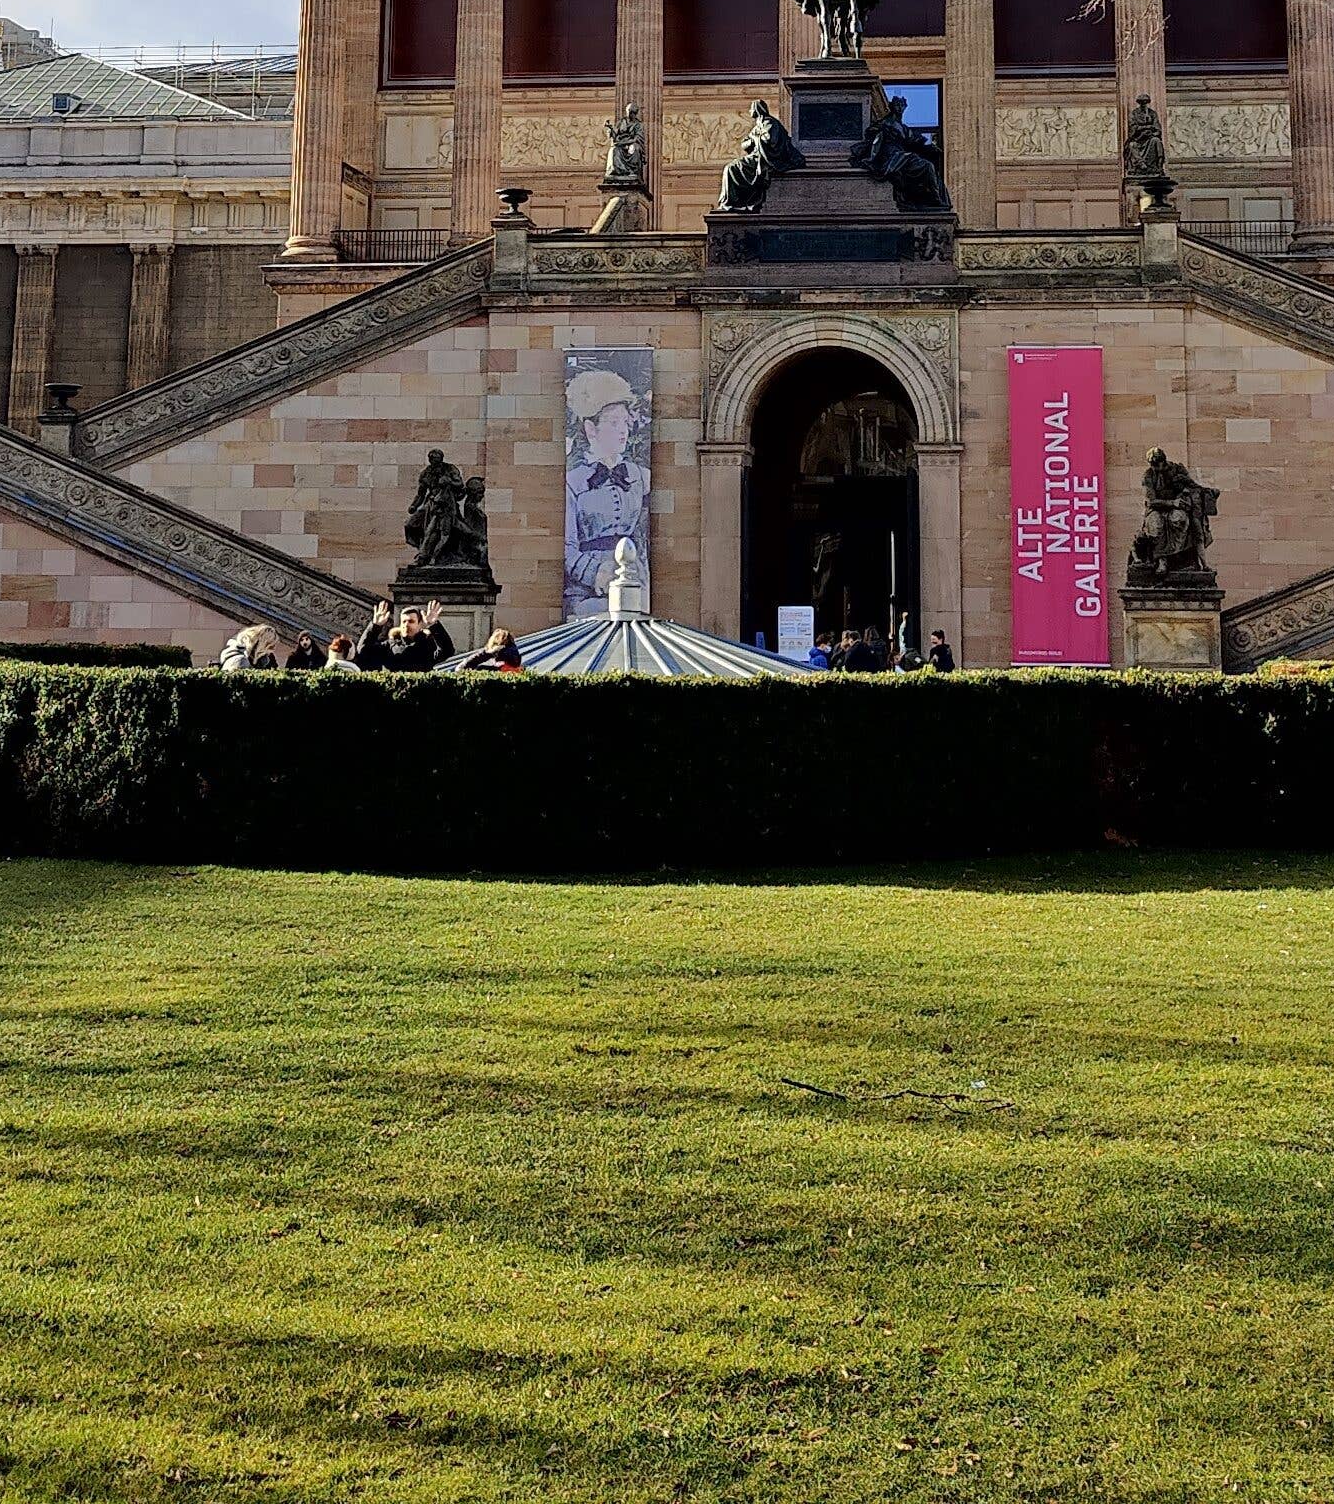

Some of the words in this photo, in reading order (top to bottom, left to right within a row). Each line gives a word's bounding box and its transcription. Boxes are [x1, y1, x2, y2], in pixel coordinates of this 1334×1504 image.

[1043, 392, 1072, 553] NATIONAL
[1017, 508, 1043, 583] ALTE
[1073, 475, 1102, 617] GALERIE
